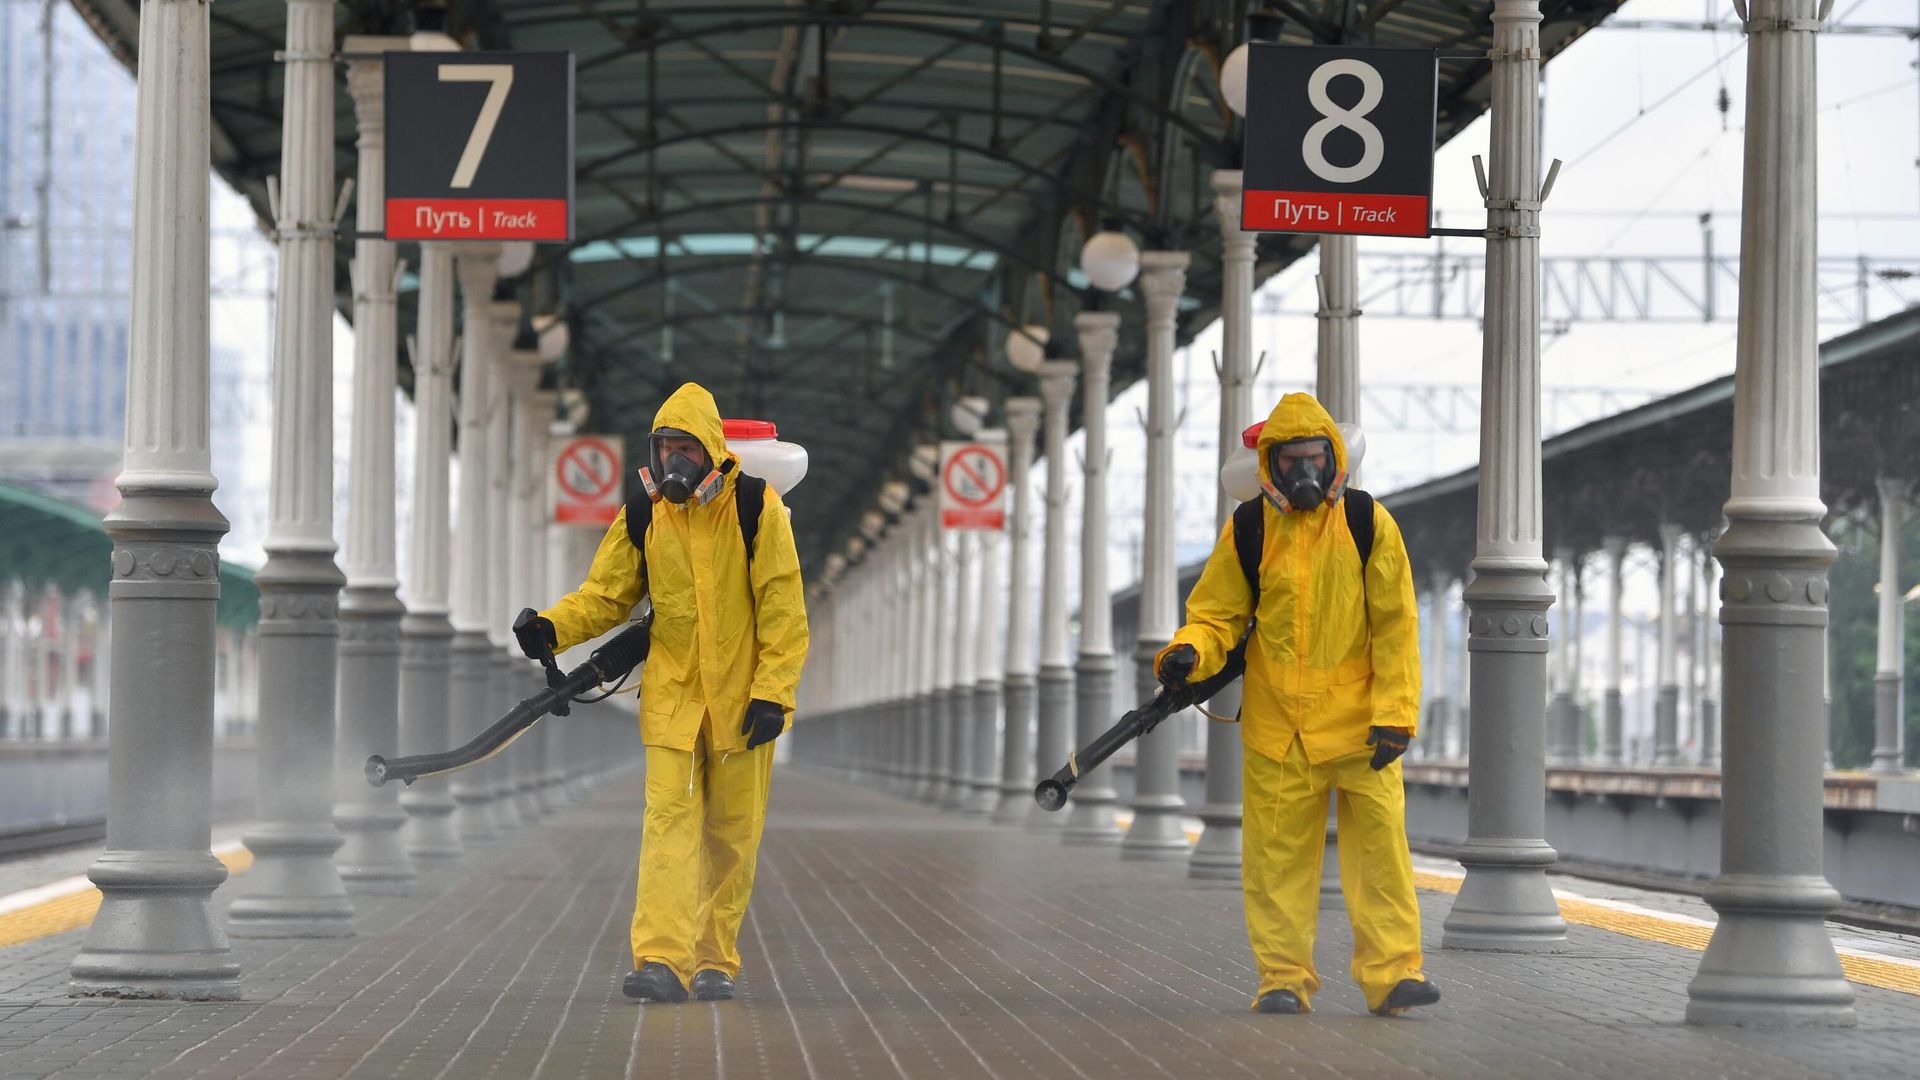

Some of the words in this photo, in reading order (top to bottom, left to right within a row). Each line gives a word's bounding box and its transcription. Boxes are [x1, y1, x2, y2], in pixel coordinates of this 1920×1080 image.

[437, 63, 515, 188] 7
[1301, 57, 1385, 184] 8
[415, 205, 473, 234] Путь
[493, 210, 538, 229] Track
[1273, 198, 1331, 225] Путь
[1352, 206, 1398, 223] Track
